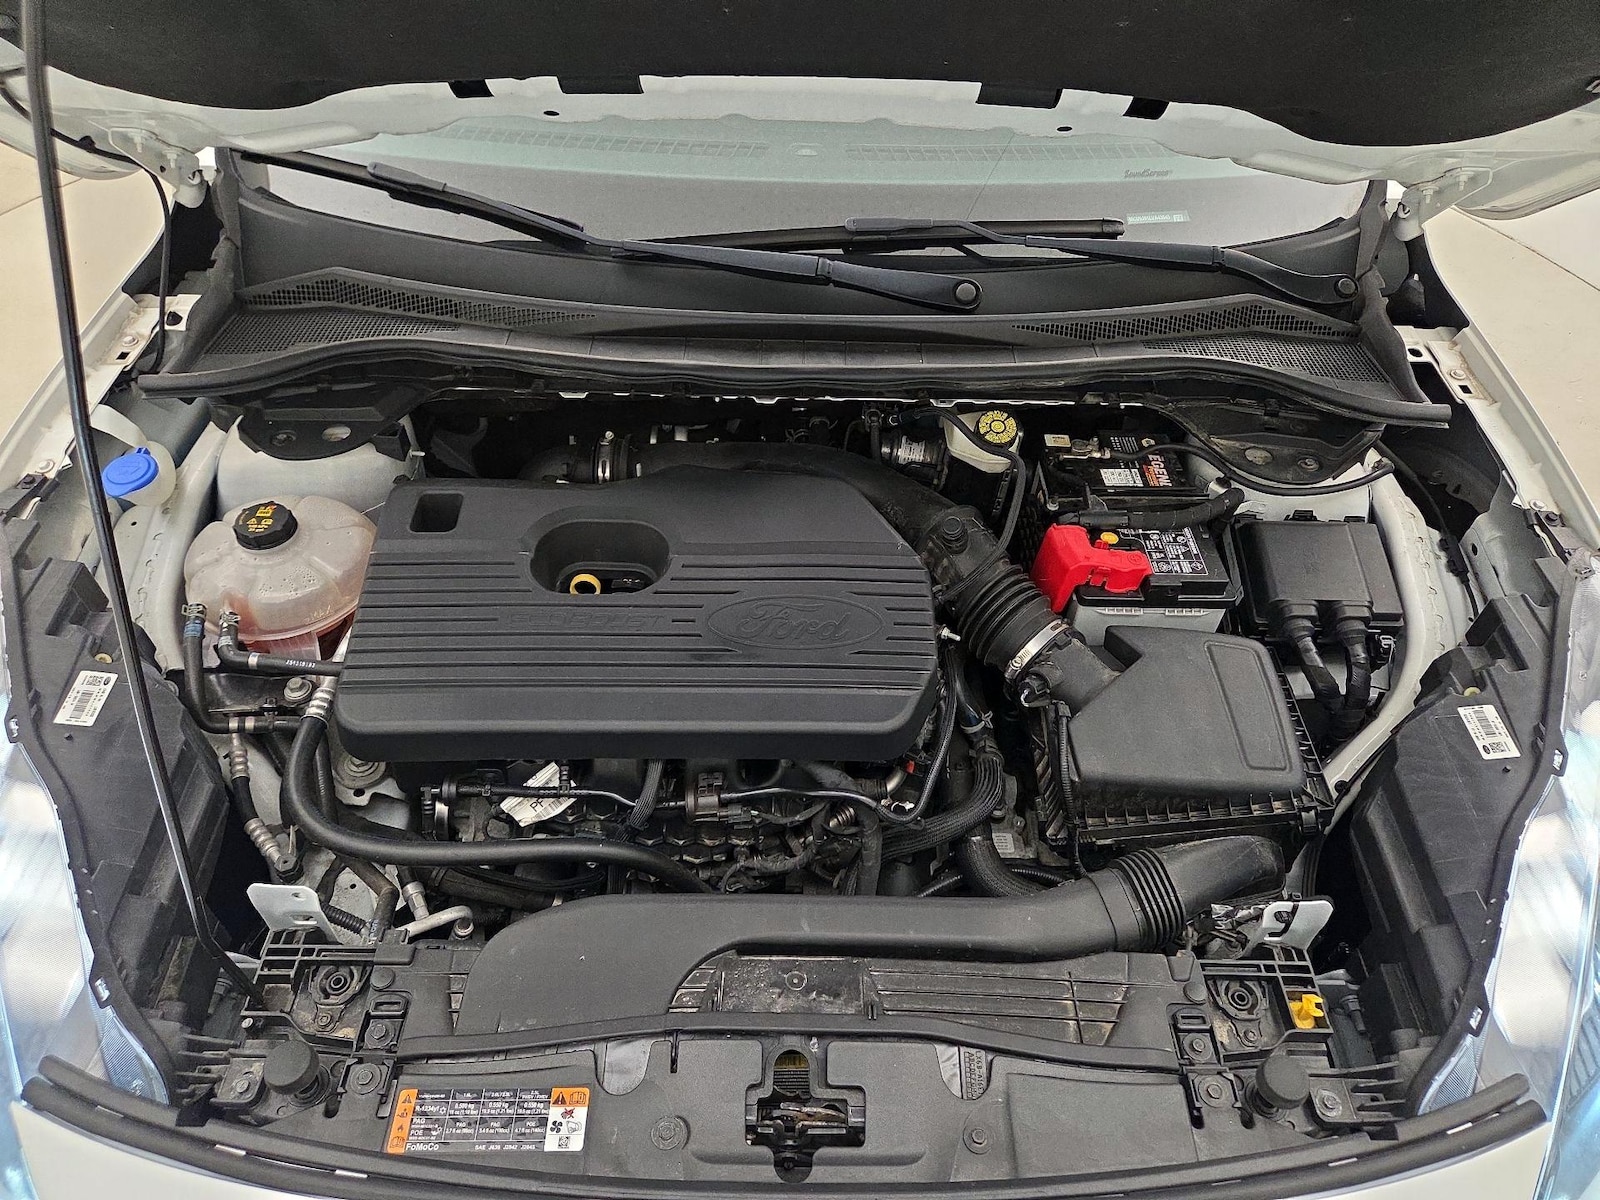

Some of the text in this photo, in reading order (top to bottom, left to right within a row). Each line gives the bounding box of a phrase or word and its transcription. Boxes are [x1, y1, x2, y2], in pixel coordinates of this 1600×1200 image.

[738, 602, 849, 641] Ford
[529, 797, 544, 812] PF
[406, 1142, 440, 1151] FoMoCo
